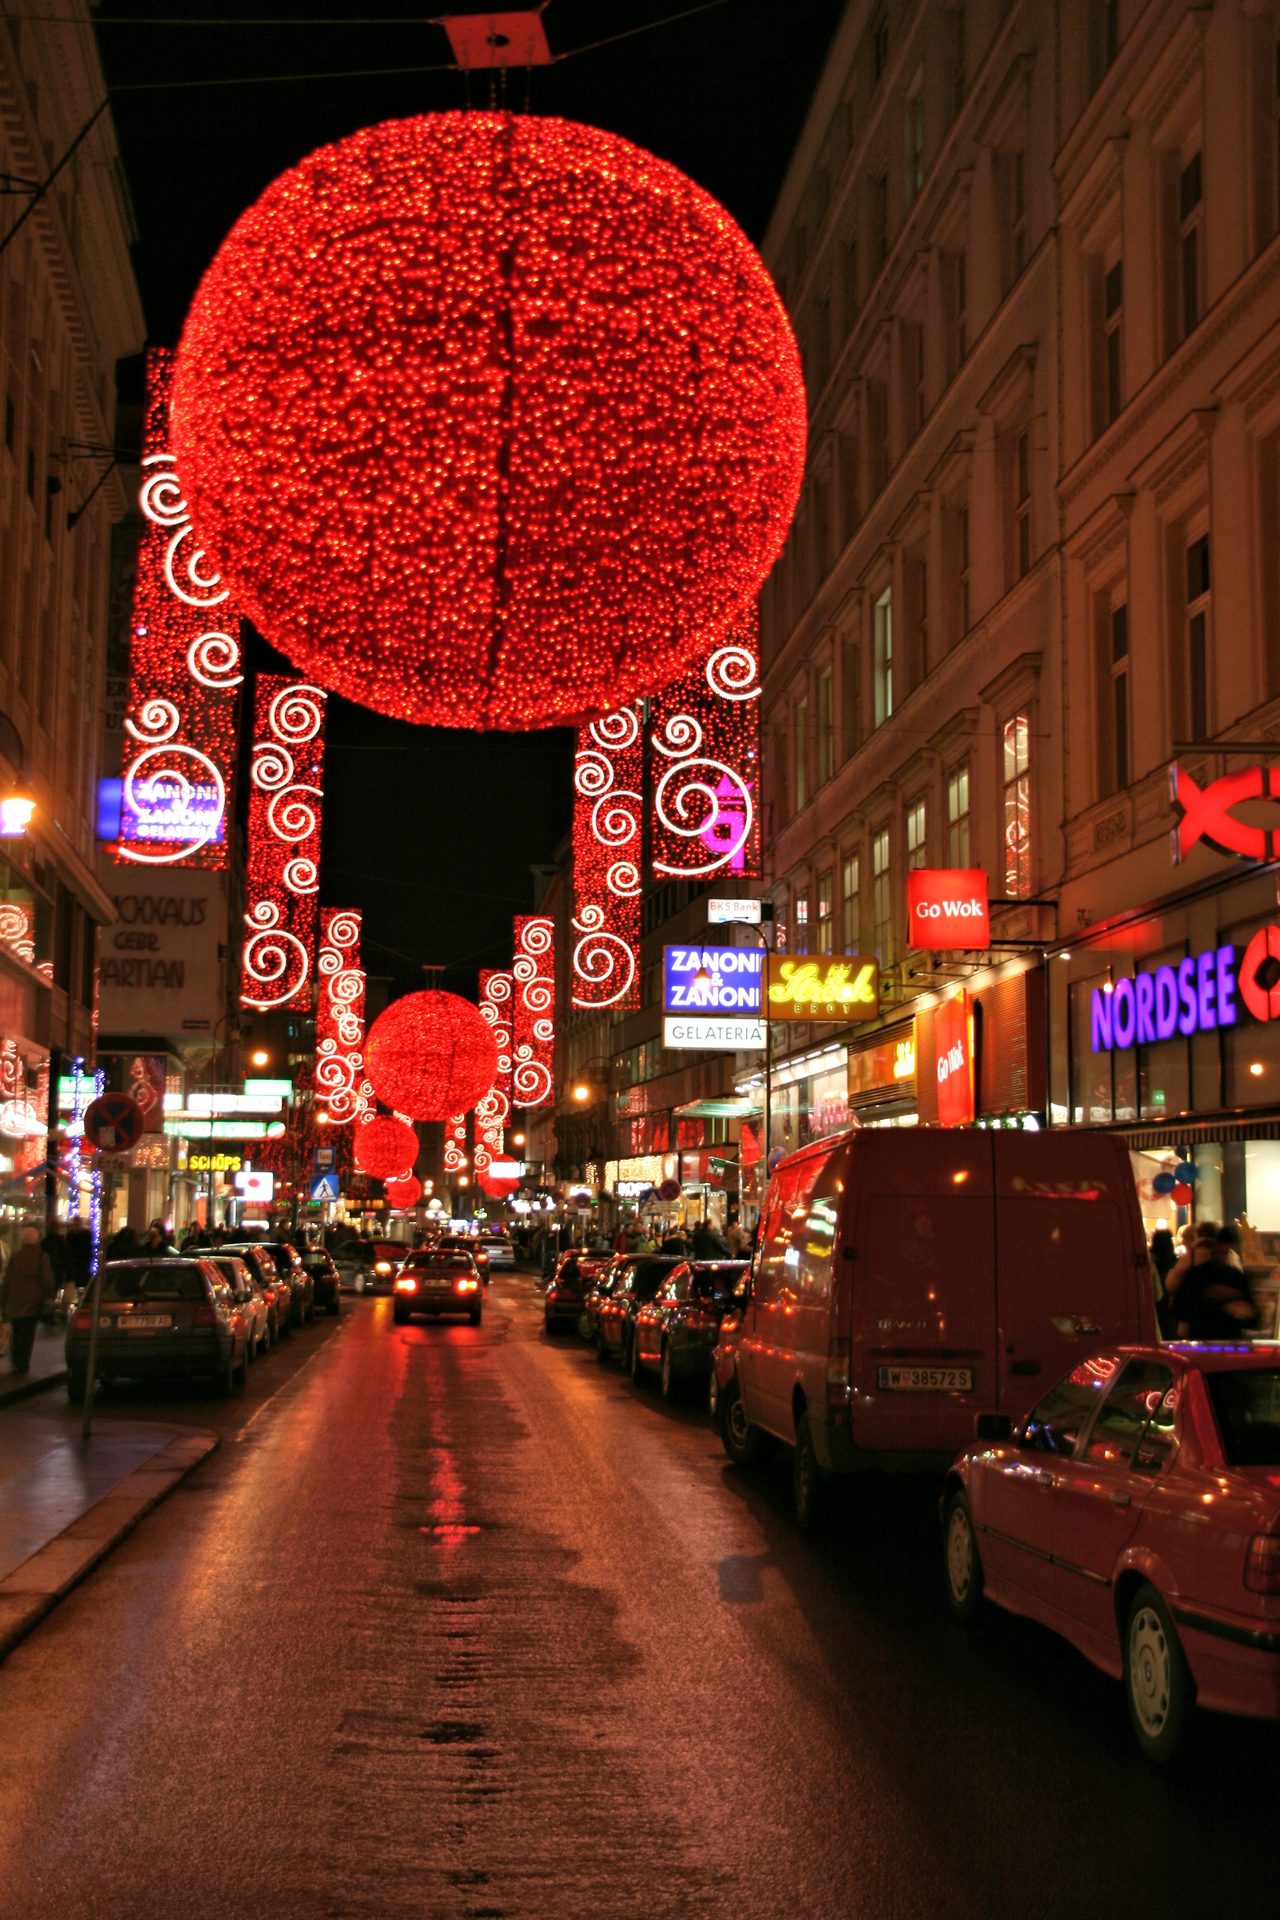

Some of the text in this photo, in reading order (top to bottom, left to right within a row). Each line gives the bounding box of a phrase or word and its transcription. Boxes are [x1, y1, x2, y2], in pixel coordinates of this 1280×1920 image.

[710, 901, 759, 912] BKS Bank
[916, 899, 984, 920] Go Wok
[671, 951, 760, 973] ZANONI
[671, 985, 760, 1007] ZANONI
[1091, 944, 1236, 1053] NORDSEE
[793, 1003, 850, 1014] BROT
[672, 1025, 762, 1041] GELATERIA
[937, 1056, 949, 1083] Go
[947, 1039, 965, 1074] Wok
[890, 1371, 901, 1385] W
